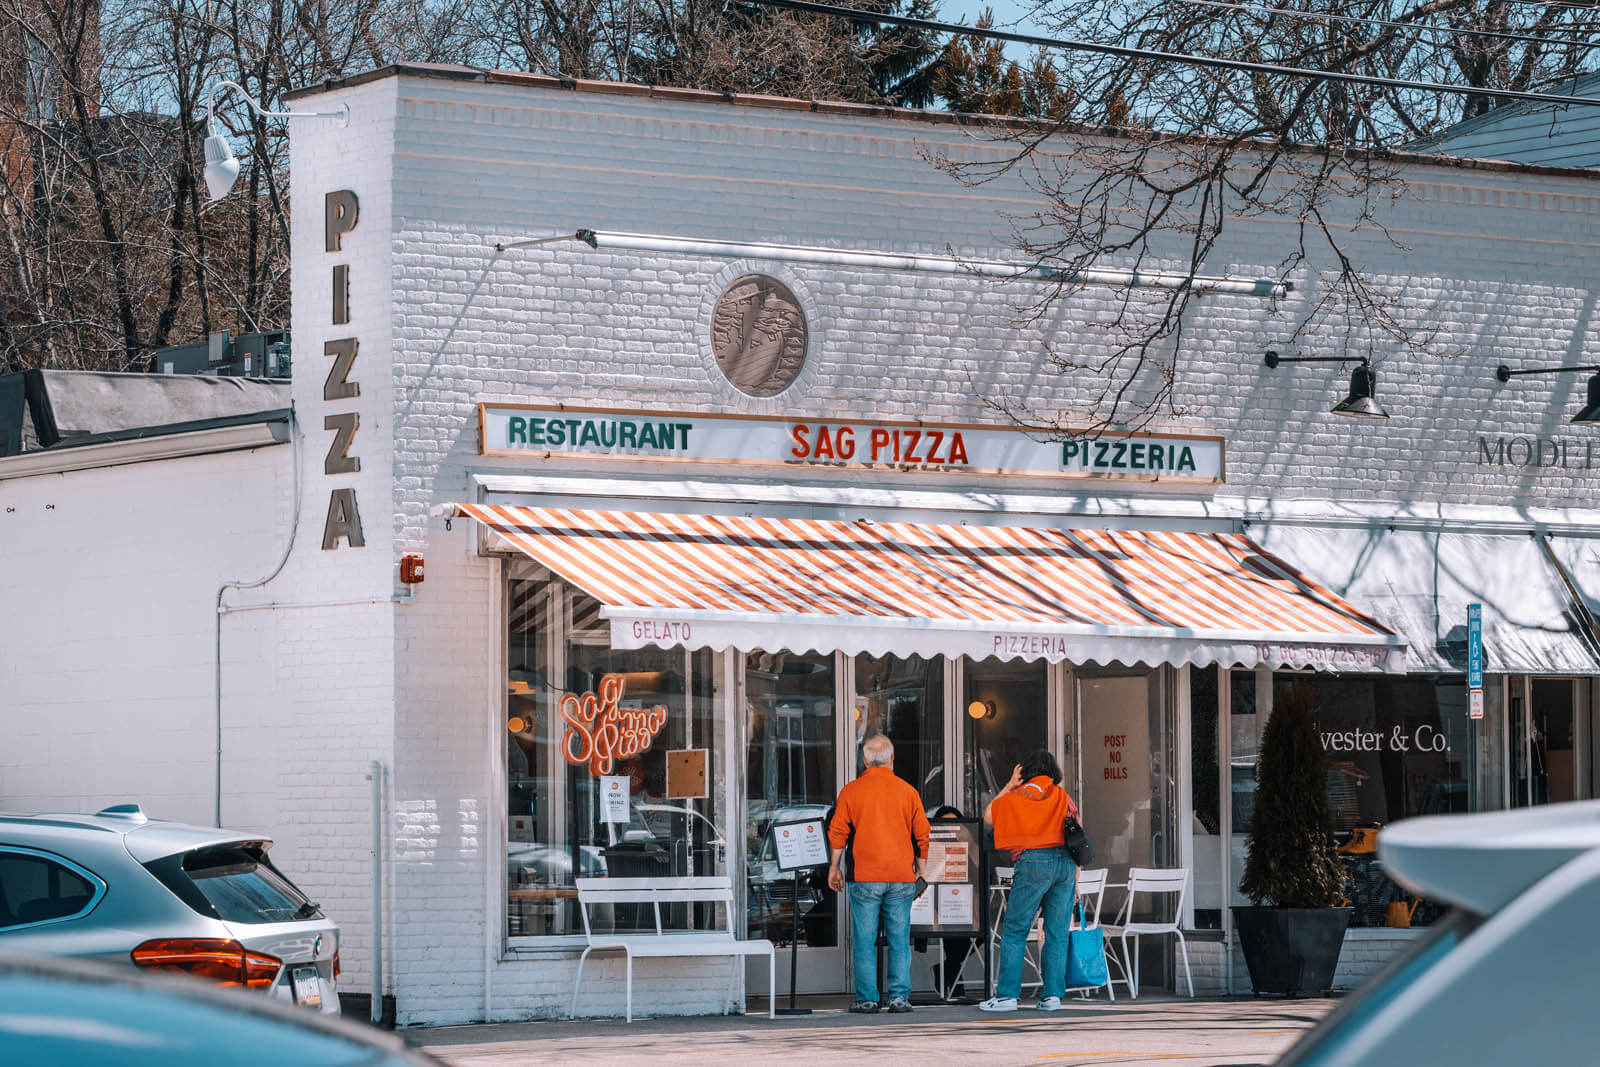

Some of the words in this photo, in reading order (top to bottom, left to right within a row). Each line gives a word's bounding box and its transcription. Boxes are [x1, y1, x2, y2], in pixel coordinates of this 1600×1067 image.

[321, 189, 366, 551] PIZZA
[508, 416, 693, 450] RESTAURANT
[791, 424, 856, 461] SAG
[870, 428, 969, 465] PIZZA
[1061, 440, 1197, 471] PIZZERIA
[632, 620, 692, 642] GELATO
[992, 634, 1067, 656] PIZZERIA
[1254, 643, 1270, 661] TO
[1279, 644, 1297, 662] GO
[1103, 734, 1127, 748] POST
[1320, 727, 1385, 752] vester
[1390, 725, 1410, 752] &
[1415, 724, 1452, 752] Co.
[1109, 751, 1122, 763] NO
[1103, 767, 1128, 780] BILLS
